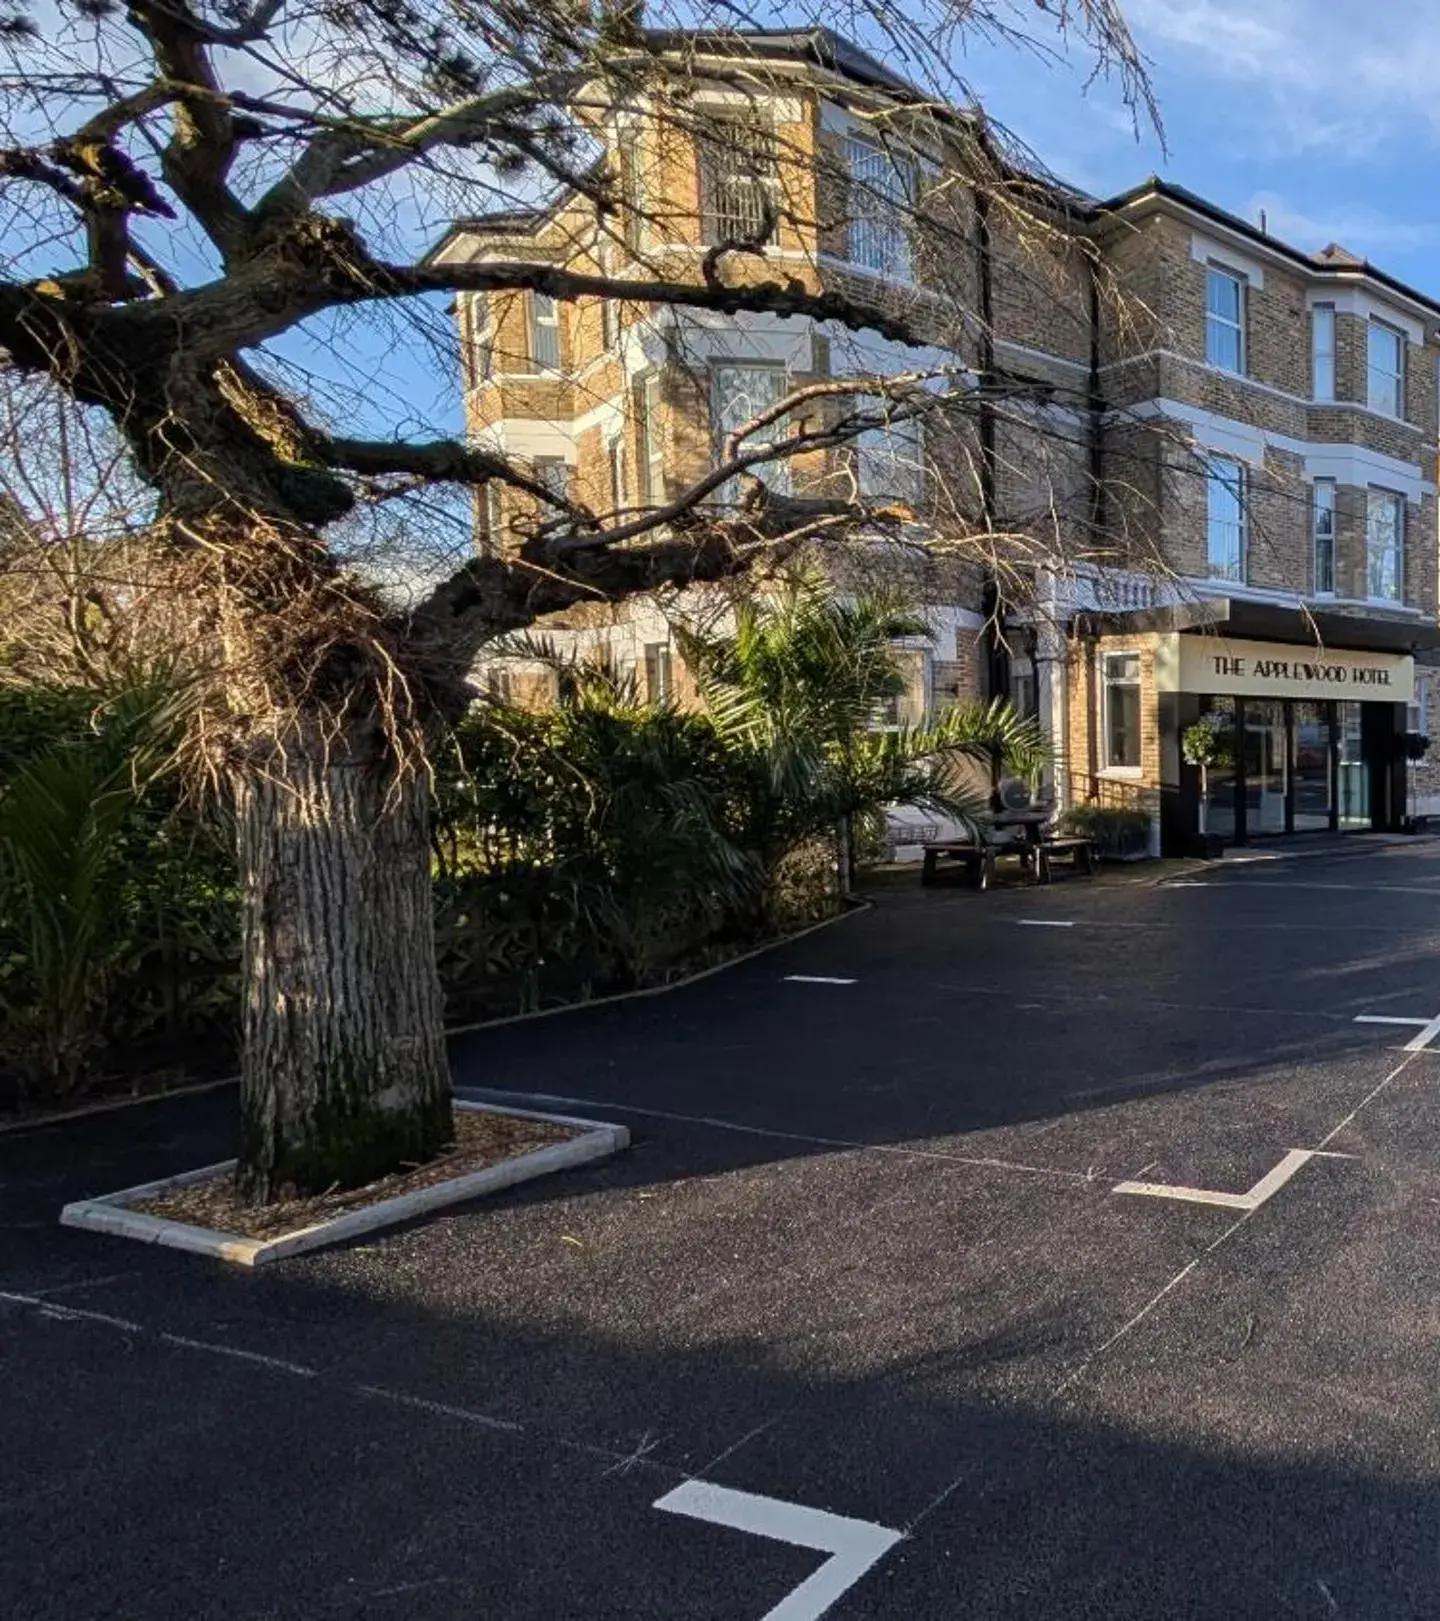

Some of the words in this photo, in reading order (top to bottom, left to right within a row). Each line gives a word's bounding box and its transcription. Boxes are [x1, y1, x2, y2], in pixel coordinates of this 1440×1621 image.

[1213, 655, 1246, 676] THE
[1254, 659, 1347, 682] APPLEWOOD
[1352, 667, 1392, 686] HOTEL
